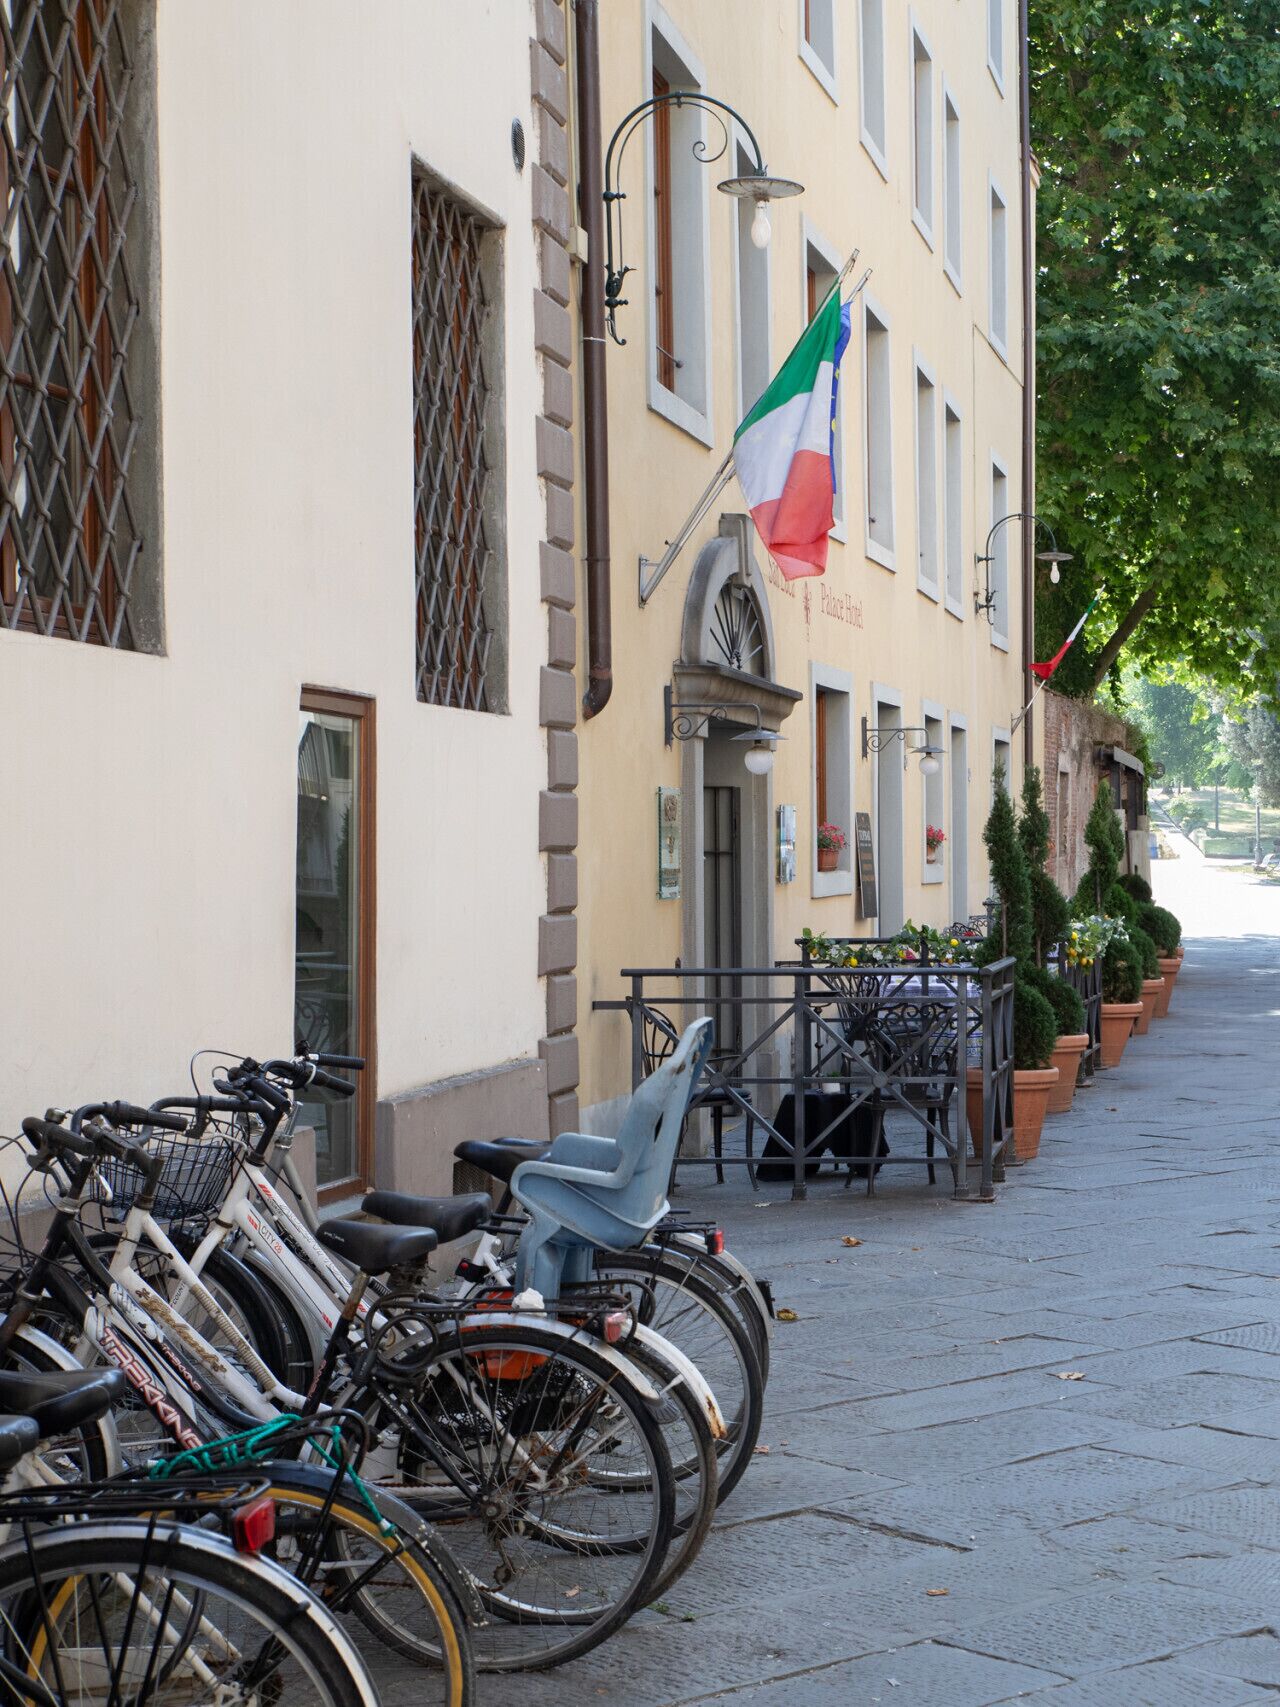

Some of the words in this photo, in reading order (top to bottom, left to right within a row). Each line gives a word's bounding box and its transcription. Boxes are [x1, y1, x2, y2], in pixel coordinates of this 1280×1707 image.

[820, 582, 843, 621] Palace
[845, 593, 864, 630] Hotel
[260, 1225, 275, 1244] CITY
[100, 1326, 203, 1449] TREKKING
